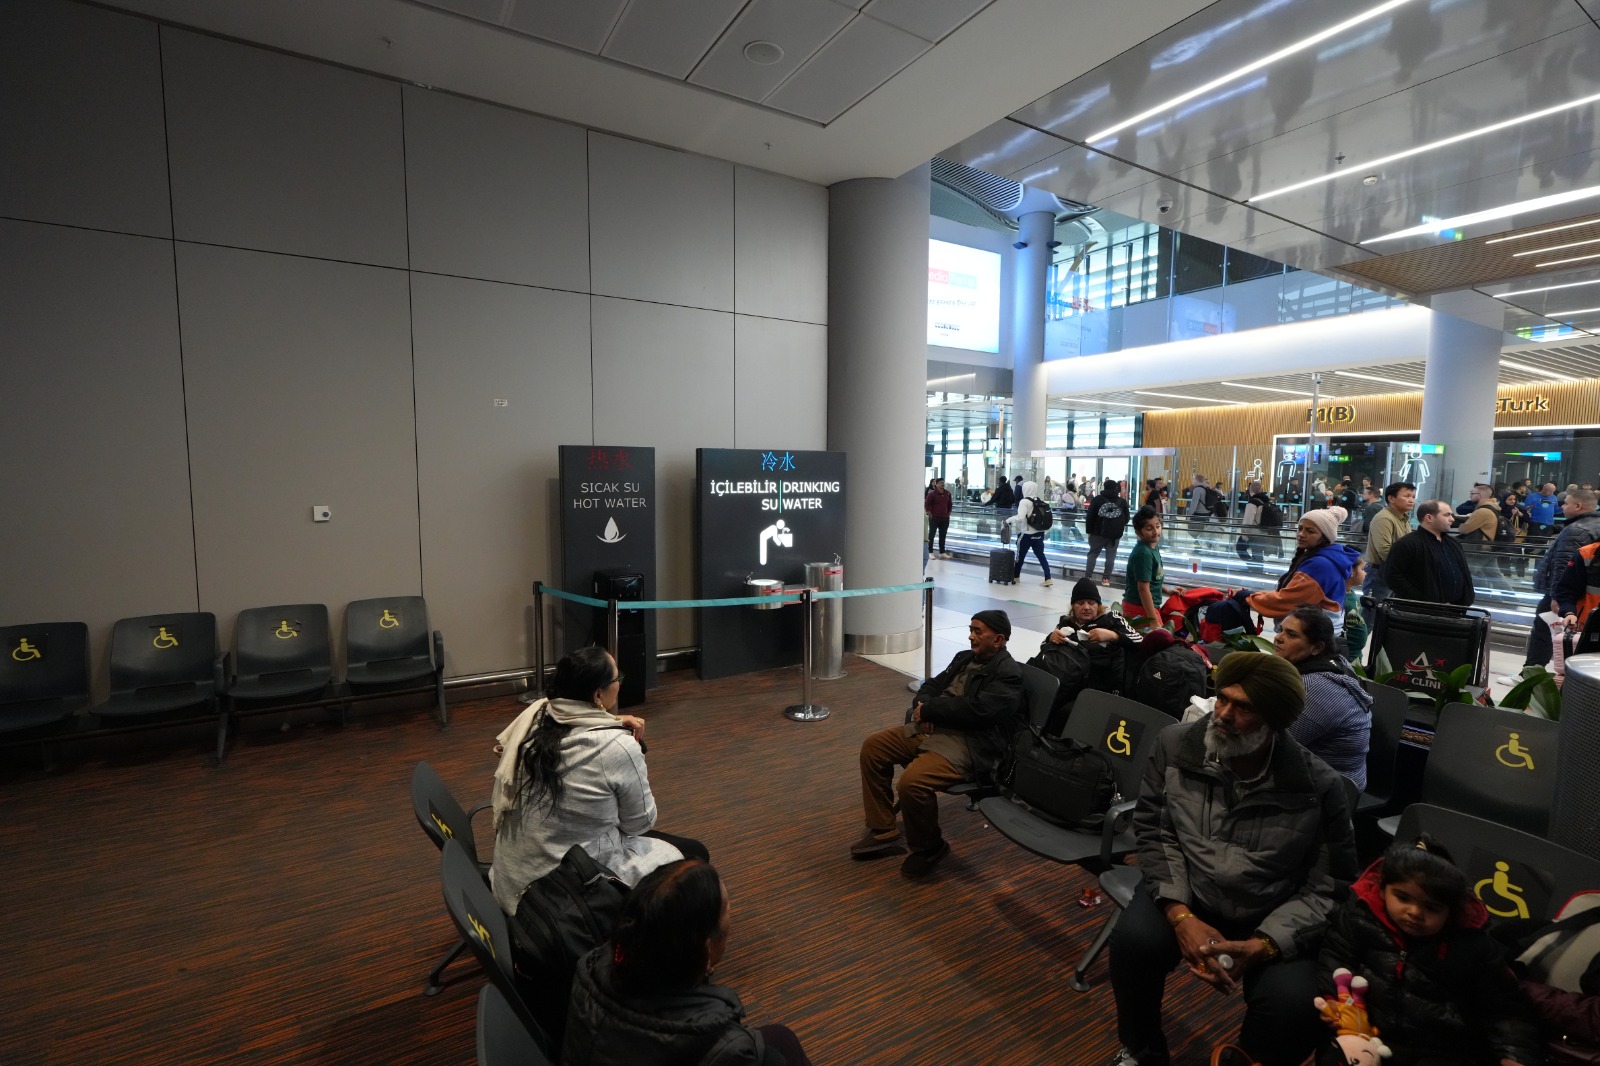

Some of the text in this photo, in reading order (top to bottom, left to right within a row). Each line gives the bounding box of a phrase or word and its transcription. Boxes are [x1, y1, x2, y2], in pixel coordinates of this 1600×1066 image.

[588, 448, 632, 471] 热水
[761, 451, 796, 471] 冷水
[580, 482, 640, 493] SICAK SU
[710, 479, 777, 496] İÇİLEBİLİR
[783, 481, 840, 493] DRINKING
[573, 497, 647, 509] HOT WATER
[761, 499, 778, 511] SU
[783, 498, 823, 510] WATER
[1411, 677, 1443, 689] CLINI
